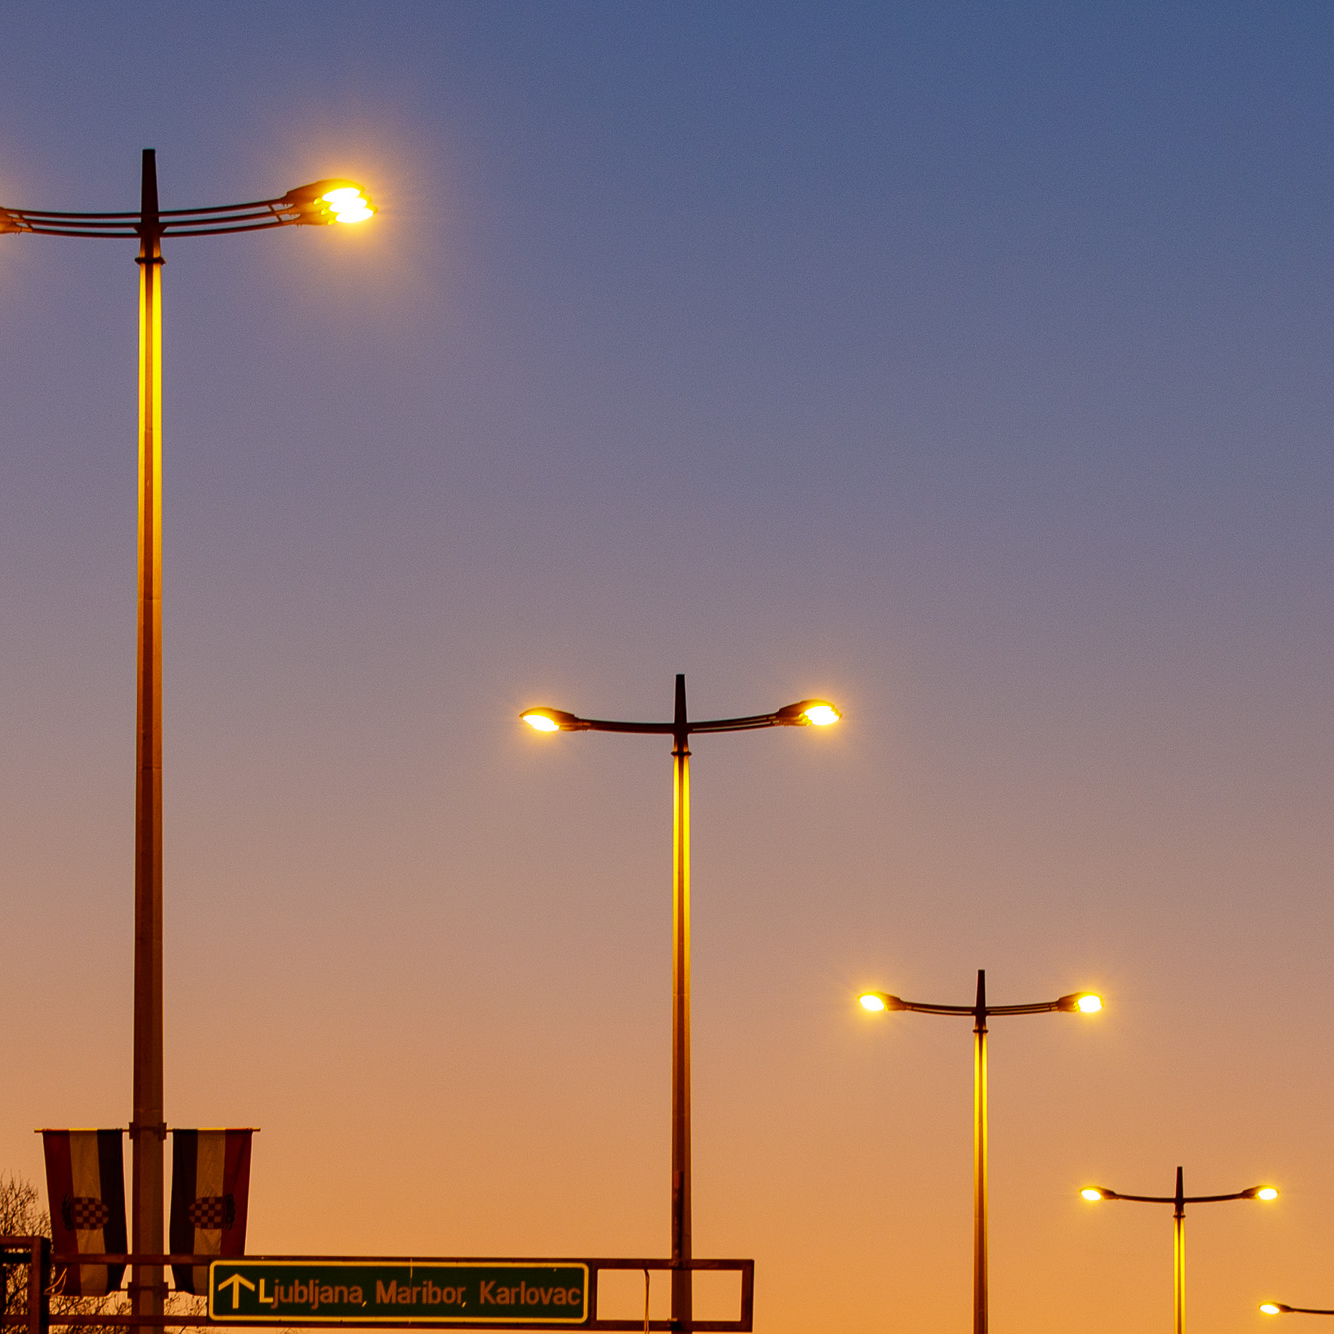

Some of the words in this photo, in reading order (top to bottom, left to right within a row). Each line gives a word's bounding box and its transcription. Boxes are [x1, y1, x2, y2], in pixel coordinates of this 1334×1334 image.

[259, 1278, 368, 1309] Ljubljana,
[375, 1280, 467, 1308] Maribor,
[479, 1280, 581, 1306] Karlovac
